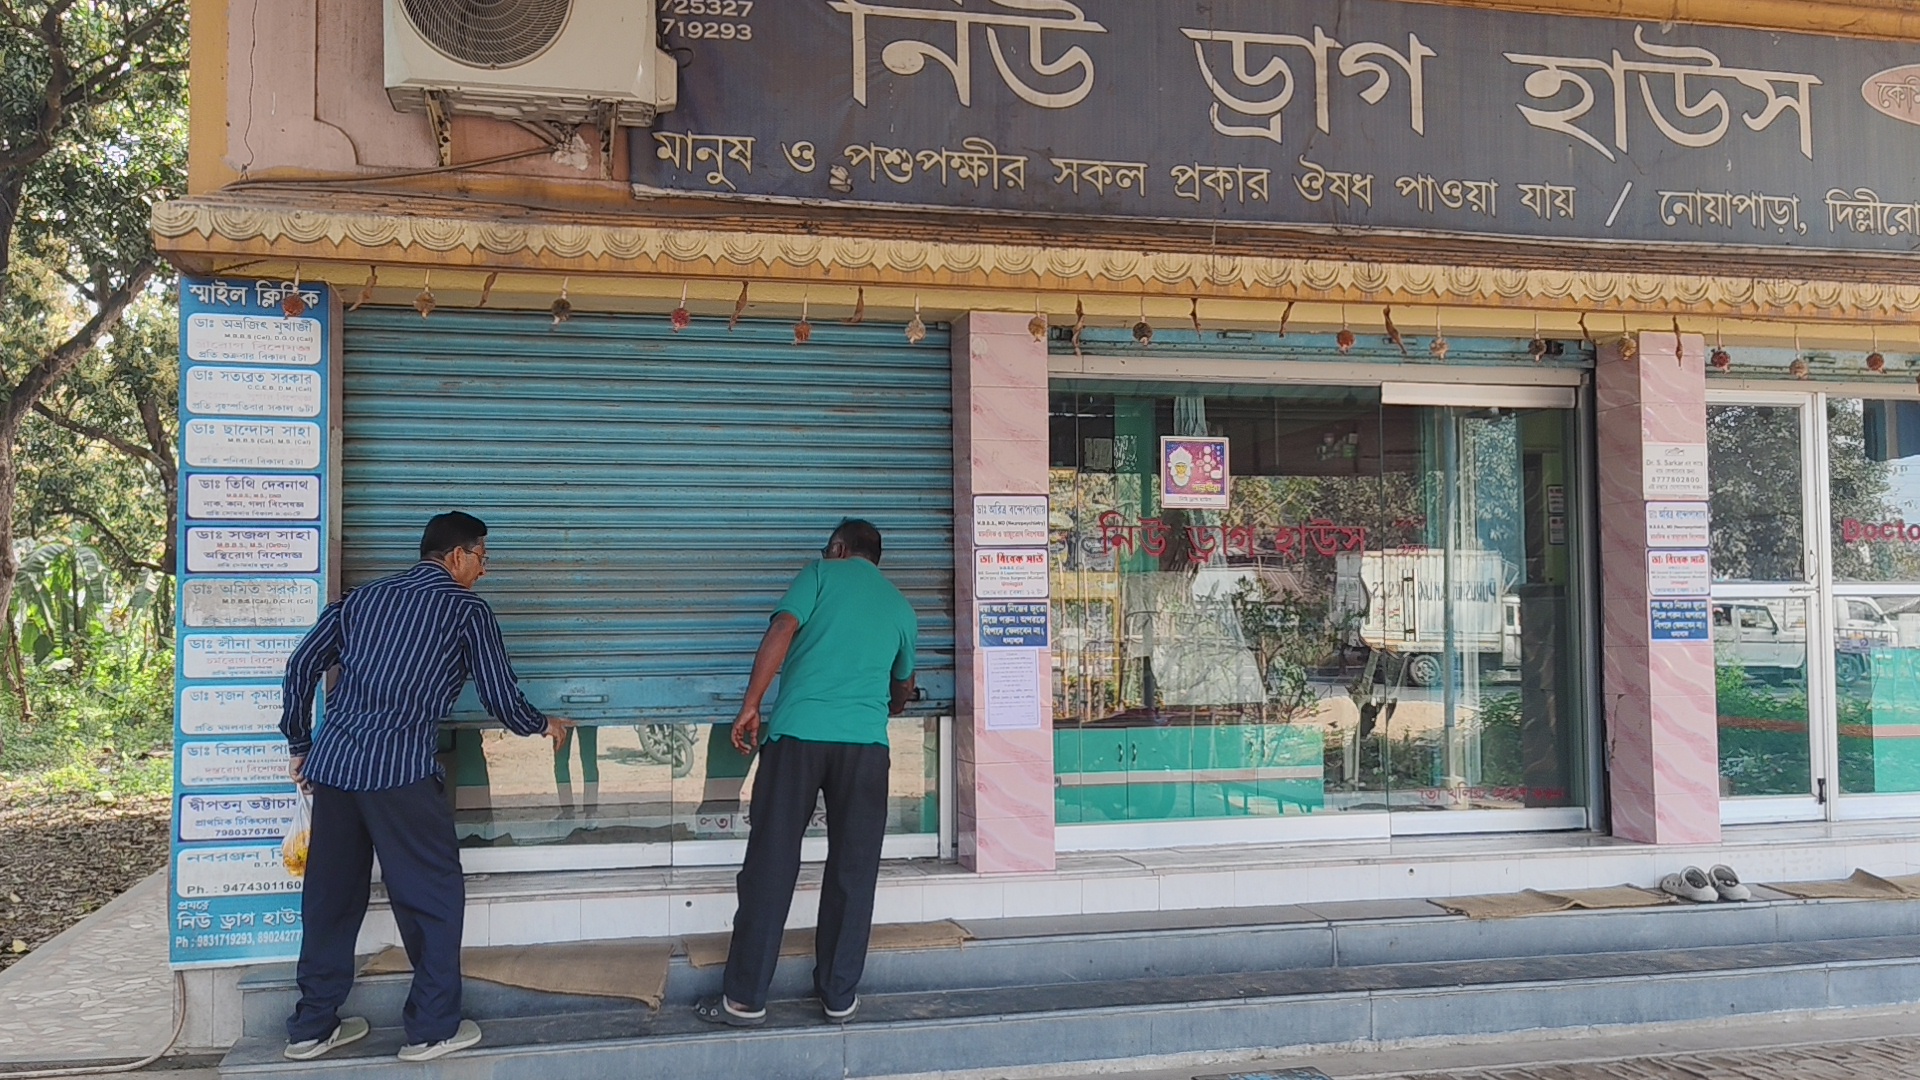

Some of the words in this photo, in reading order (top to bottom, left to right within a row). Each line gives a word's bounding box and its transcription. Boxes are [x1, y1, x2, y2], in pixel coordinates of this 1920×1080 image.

[826, 0, 1108, 108] নিউ
[1179, 24, 1437, 145] ড্রাগ
[1502, 23, 1824, 163] হাউস
[652, 130, 757, 191] মানুষ
[781, 139, 817, 173] ও
[843, 136, 1028, 191] পশুপক্ষীর
[1049, 156, 1149, 197] সকল
[1169, 161, 1271, 203] প্রকার
[1292, 154, 1374, 209] ঔষধ
[1394, 174, 1499, 218] পাওয়া
[1517, 181, 1576, 220] যায়
[188, 279, 248, 307] স্মাইল
[193, 318, 214, 328] ডাঃ
[193, 370, 214, 381] ডাঃ
[271, 373, 312, 385] সরকার
[191, 424, 215, 435] ডাঃ
[282, 425, 311, 438] সাহা
[198, 479, 221, 490] ডাঃ
[225, 476, 255, 490] তিথি
[262, 480, 309, 491] দেবনাথ
[195, 530, 222, 540] ডাঃ
[228, 530, 270, 540] সজল
[276, 531, 311, 541] সাহা
[1097, 509, 1171, 557] নিউ
[1185, 521, 1257, 563] ড্রাগ
[1270, 519, 1369, 562] হাউস
[190, 584, 213, 595] ডাঃ
[220, 580, 260, 595] অমিত
[189, 638, 213, 649] ডাঃ
[218, 636, 250, 650] লীনা
[189, 690, 209, 701] ডাঃ
[187, 747, 210, 757] ডাঃ
[222, 880, 302, 893] 9474301160
[176, 910, 214, 930] নিউ
[219, 911, 255, 930] ড্রাগ
